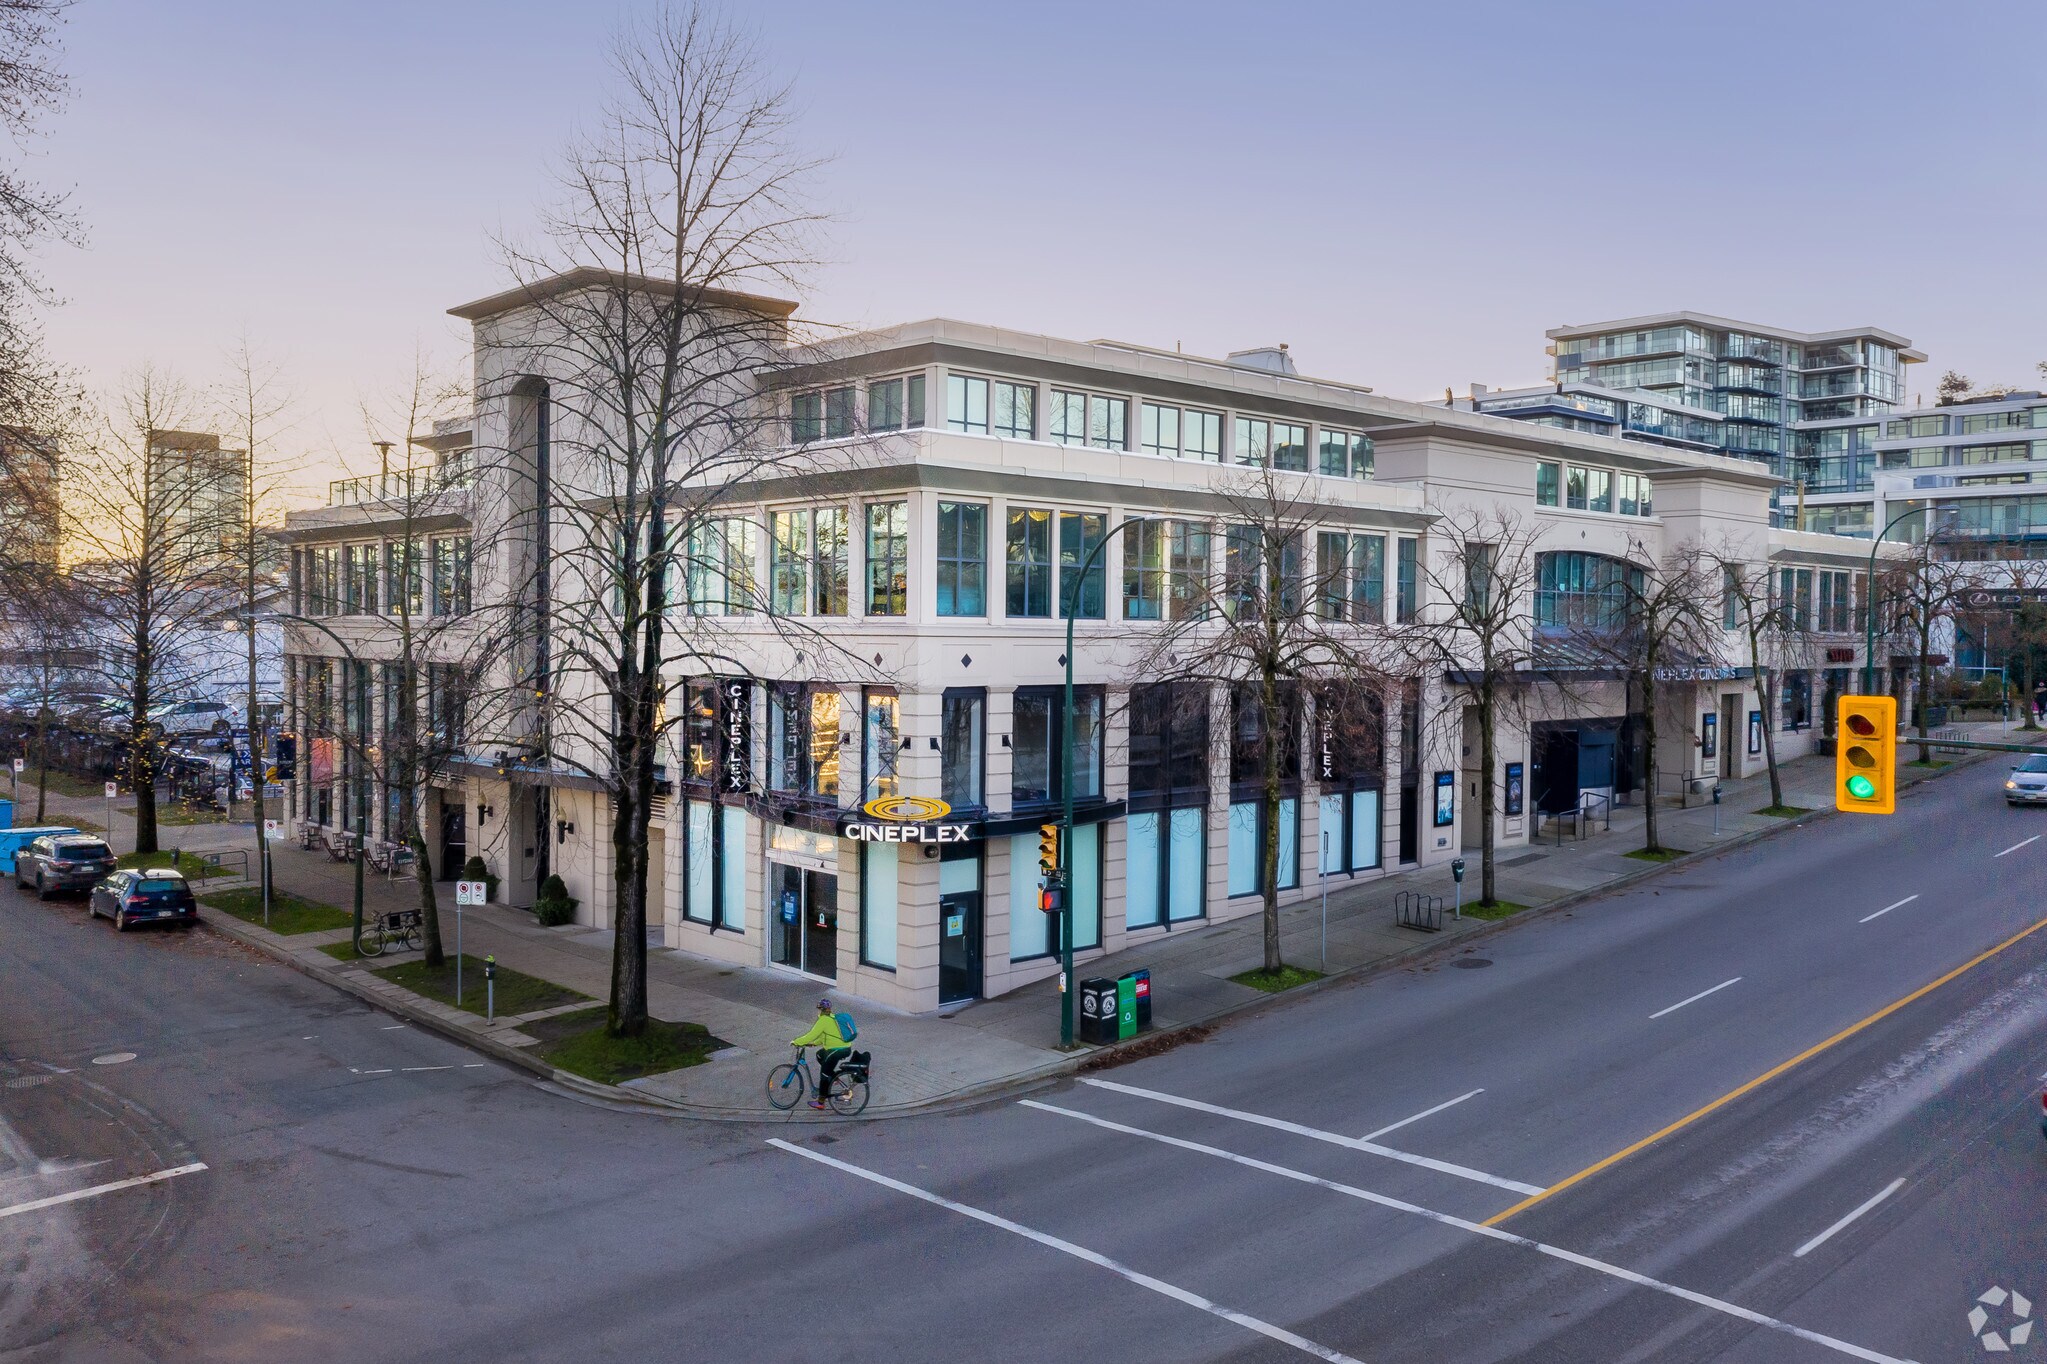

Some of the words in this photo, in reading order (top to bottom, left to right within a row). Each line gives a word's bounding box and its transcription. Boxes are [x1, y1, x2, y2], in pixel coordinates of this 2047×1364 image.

[1641, 667, 1695, 681] NEPLEX
[730, 685, 742, 788] CINEPLEX
[1323, 686, 1332, 777] NEPLEX
[845, 824, 970, 843] CINEPLEX
